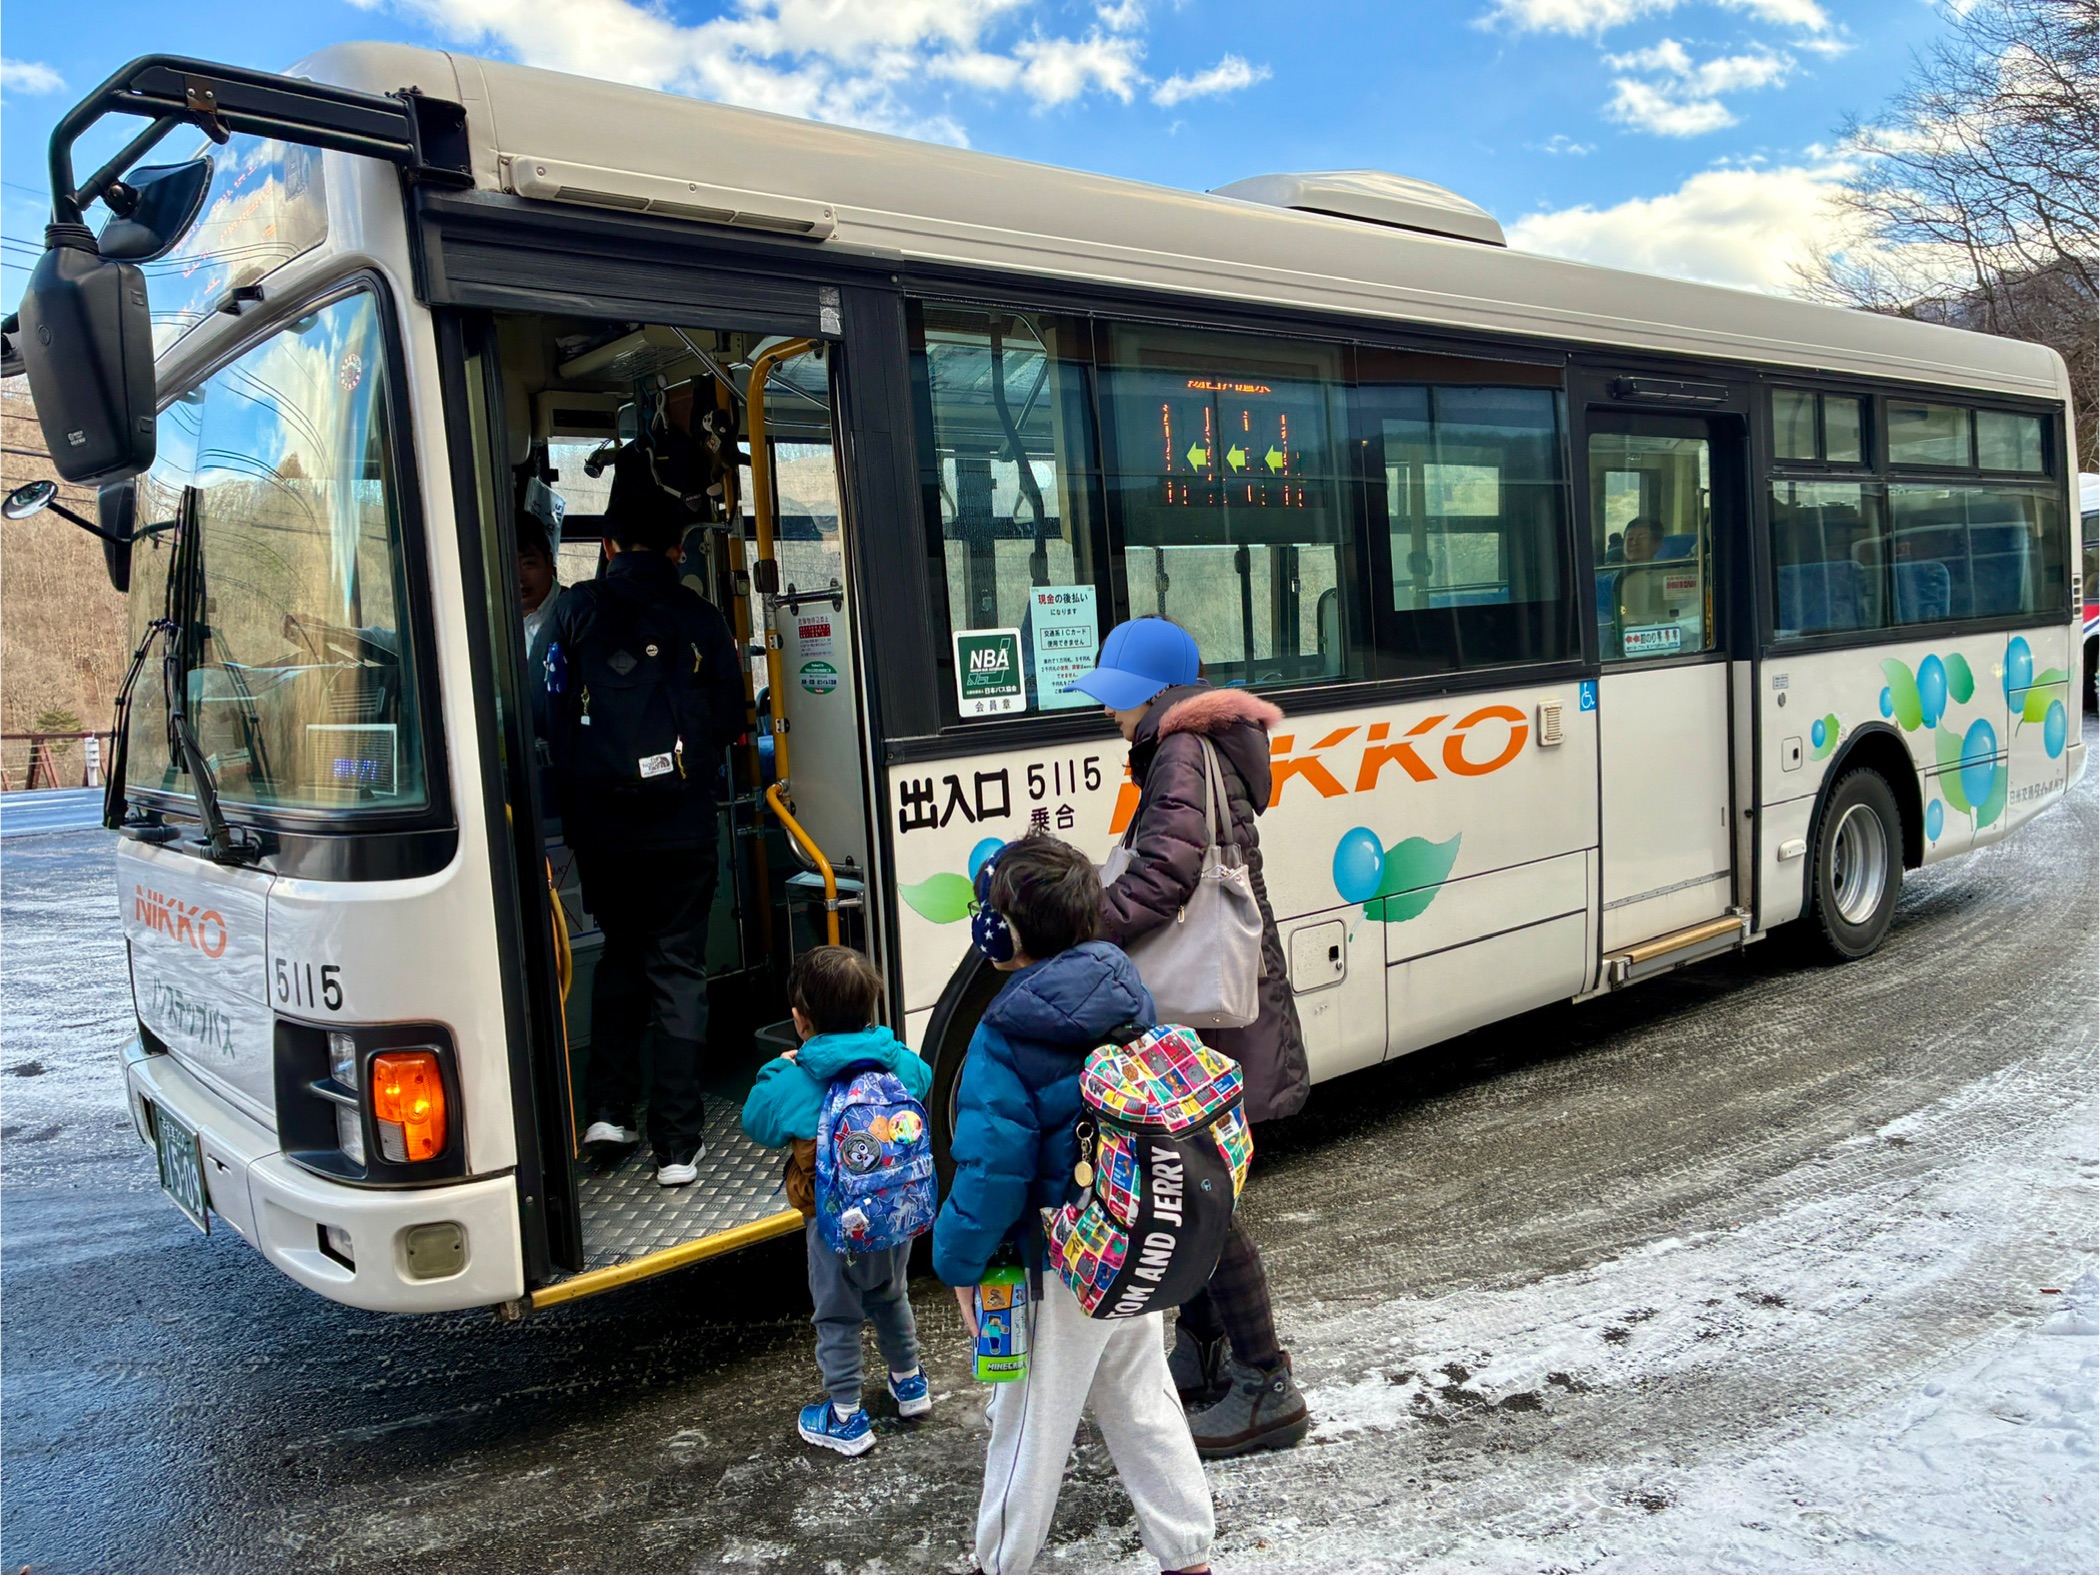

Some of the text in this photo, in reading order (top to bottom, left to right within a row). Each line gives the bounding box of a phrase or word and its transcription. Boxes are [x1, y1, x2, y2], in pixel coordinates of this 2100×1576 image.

[1038, 592, 1088, 605] 現金の後払い
[1050, 608, 1077, 616] になります
[970, 649, 1009, 669] NBA
[899, 756, 1101, 834] 出入口 5115
[1031, 803, 1075, 831] 乗合
[136, 884, 227, 959] NIKKO
[275, 958, 343, 1011] 5115
[1151, 1146, 1183, 1227] JERRY
[1134, 1232, 1176, 1282] AND
